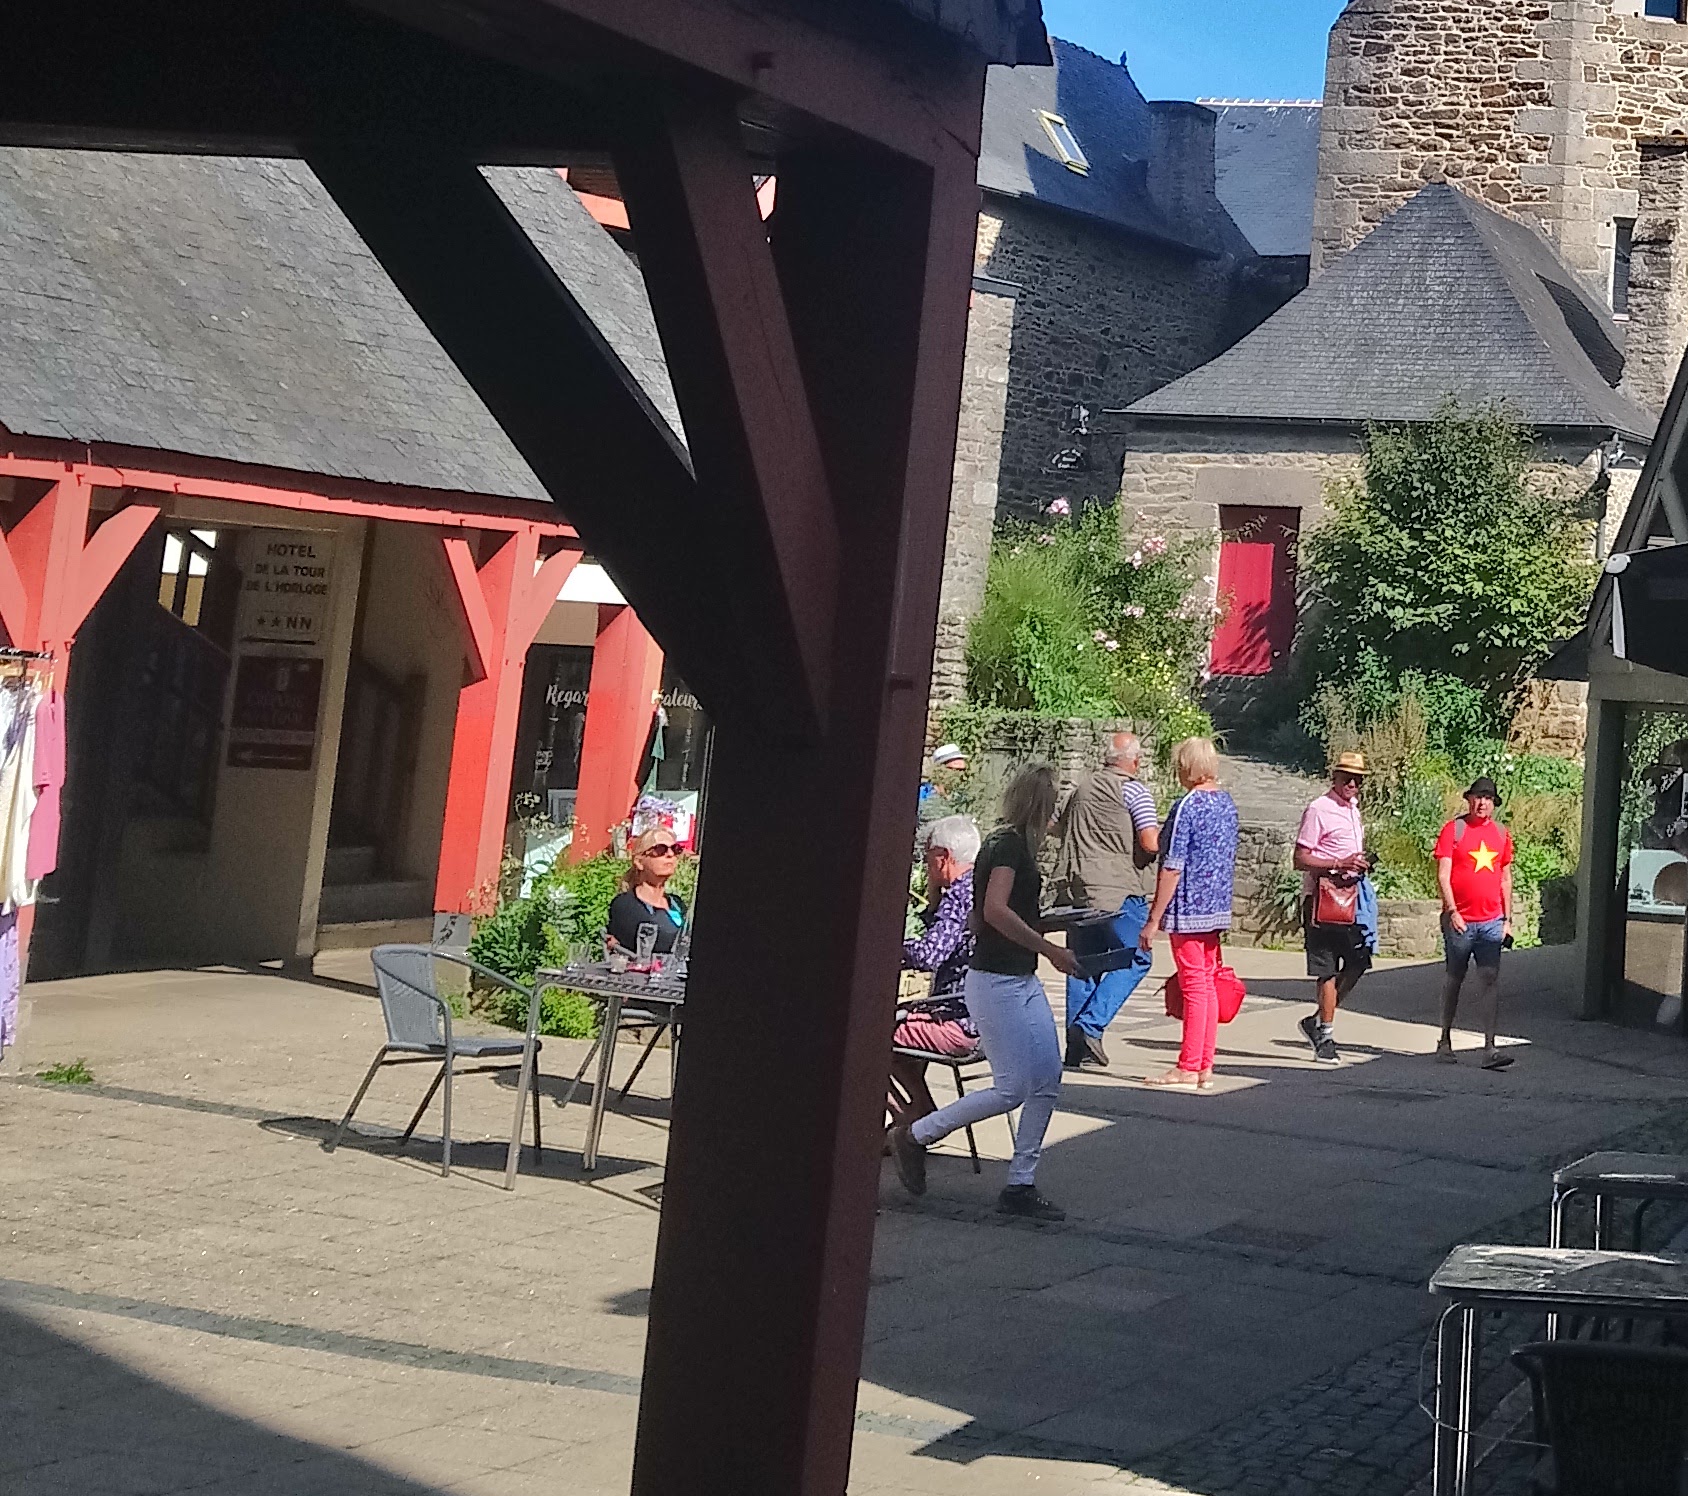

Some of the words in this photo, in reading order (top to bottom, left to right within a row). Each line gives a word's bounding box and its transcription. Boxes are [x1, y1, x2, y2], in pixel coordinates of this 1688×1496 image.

[267, 543, 316, 559] HOTEL
[255, 563, 269, 575] DE
[273, 565, 289, 576] LA
[293, 565, 326, 578] TOUR
[246, 580, 260, 591] DE
[545, 683, 589, 709] Regar
